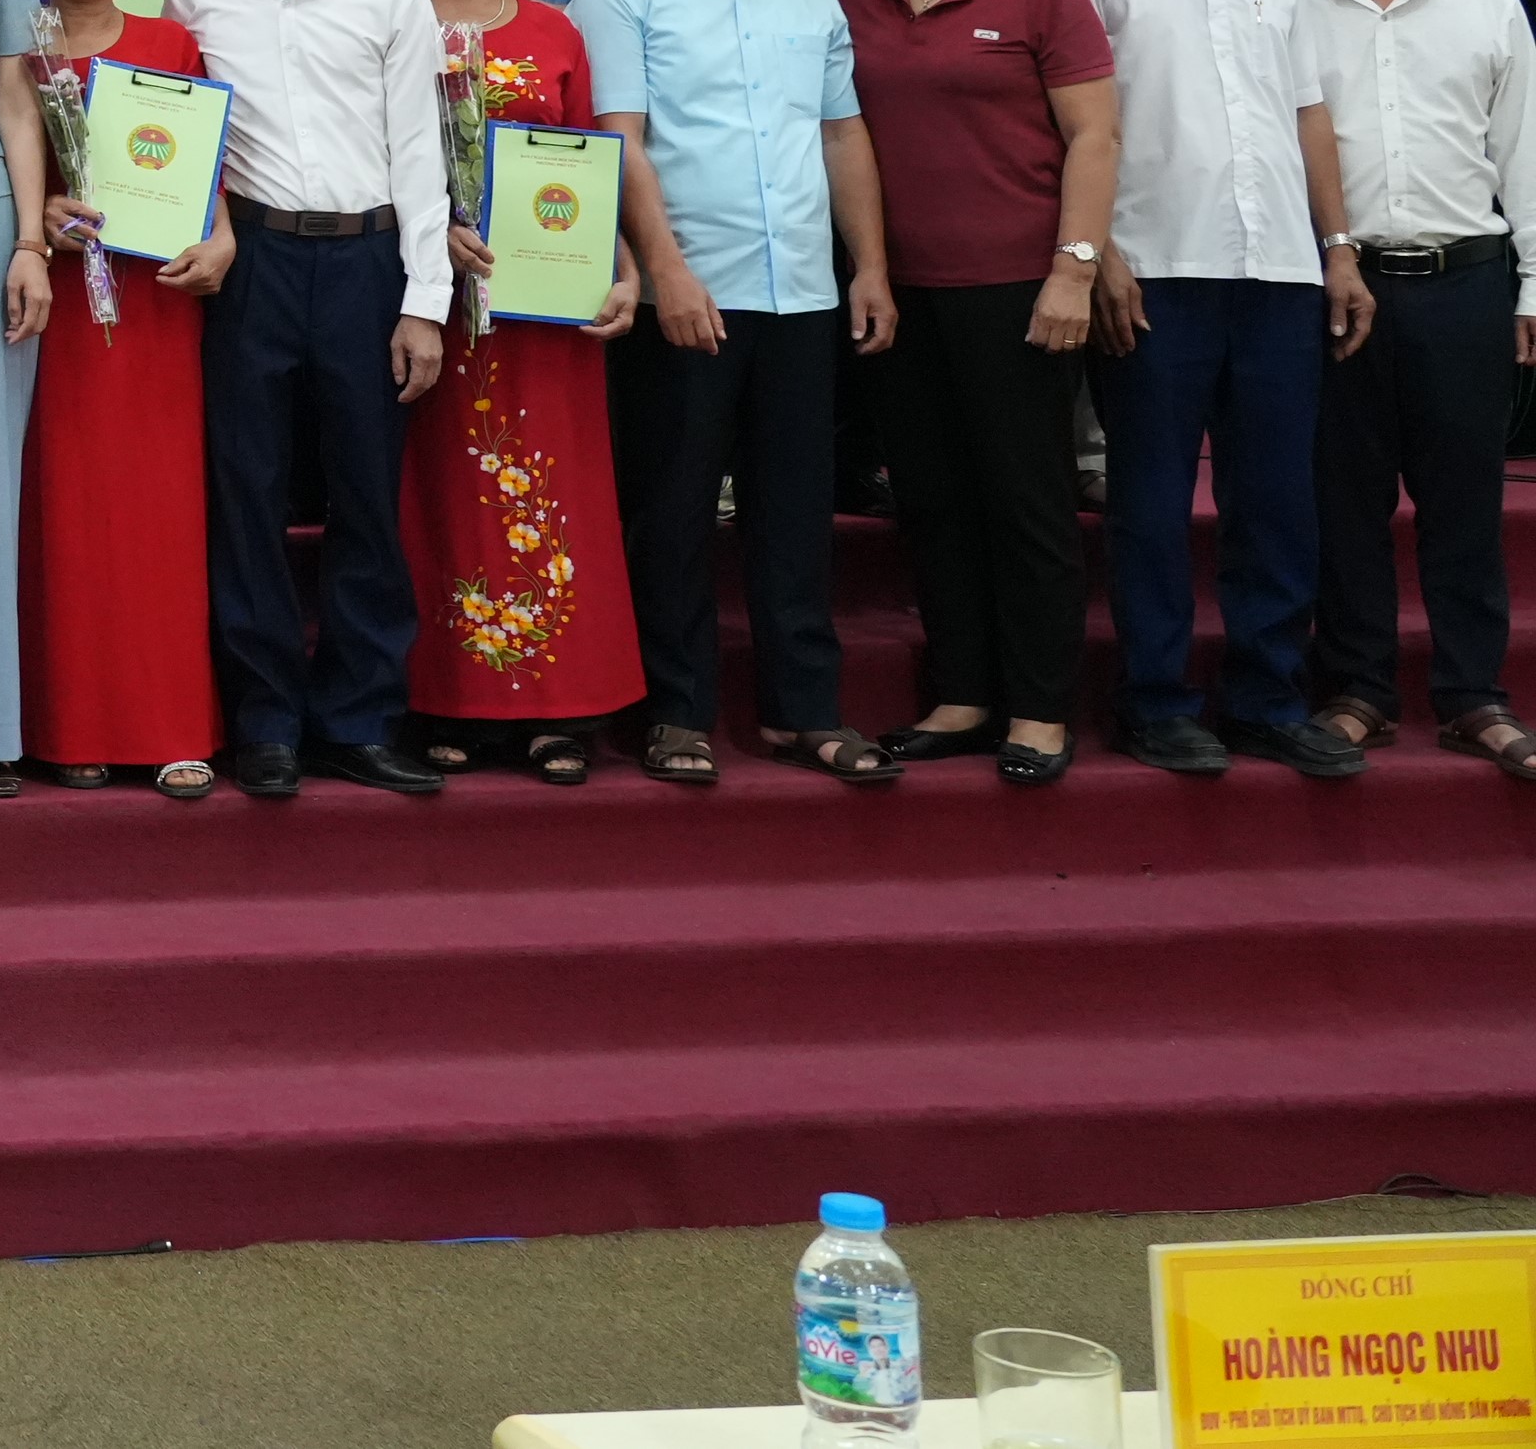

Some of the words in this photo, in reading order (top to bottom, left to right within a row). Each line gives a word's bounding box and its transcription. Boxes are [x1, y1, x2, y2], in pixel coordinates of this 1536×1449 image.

[1372, 1268, 1414, 1297] CHÍ
[1223, 1327, 1331, 1382] HOÀNG
[1340, 1330, 1426, 1385] NGỌC
[1434, 1328, 1501, 1374] NHU
